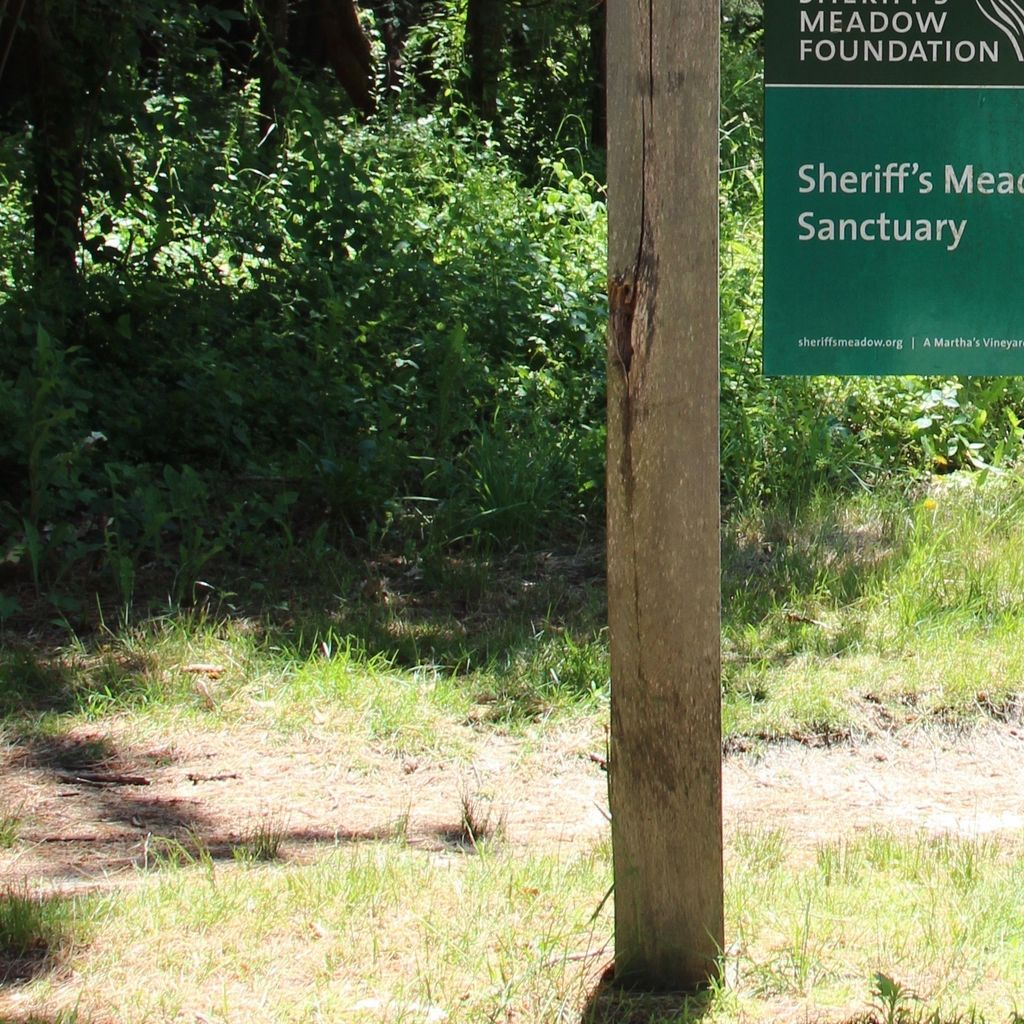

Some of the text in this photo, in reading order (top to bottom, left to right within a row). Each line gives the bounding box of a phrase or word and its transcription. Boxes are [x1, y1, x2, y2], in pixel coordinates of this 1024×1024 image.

[800, 10, 948, 33] MEADOW
[800, 39, 999, 63] FOUNDATION
[798, 162, 933, 194] Sheriff's
[798, 211, 967, 251] Sanctuary
[798, 336, 904, 350] sheriffsmeadow.org
[923, 337, 931, 347] A
[933, 336, 981, 348] Martha's
